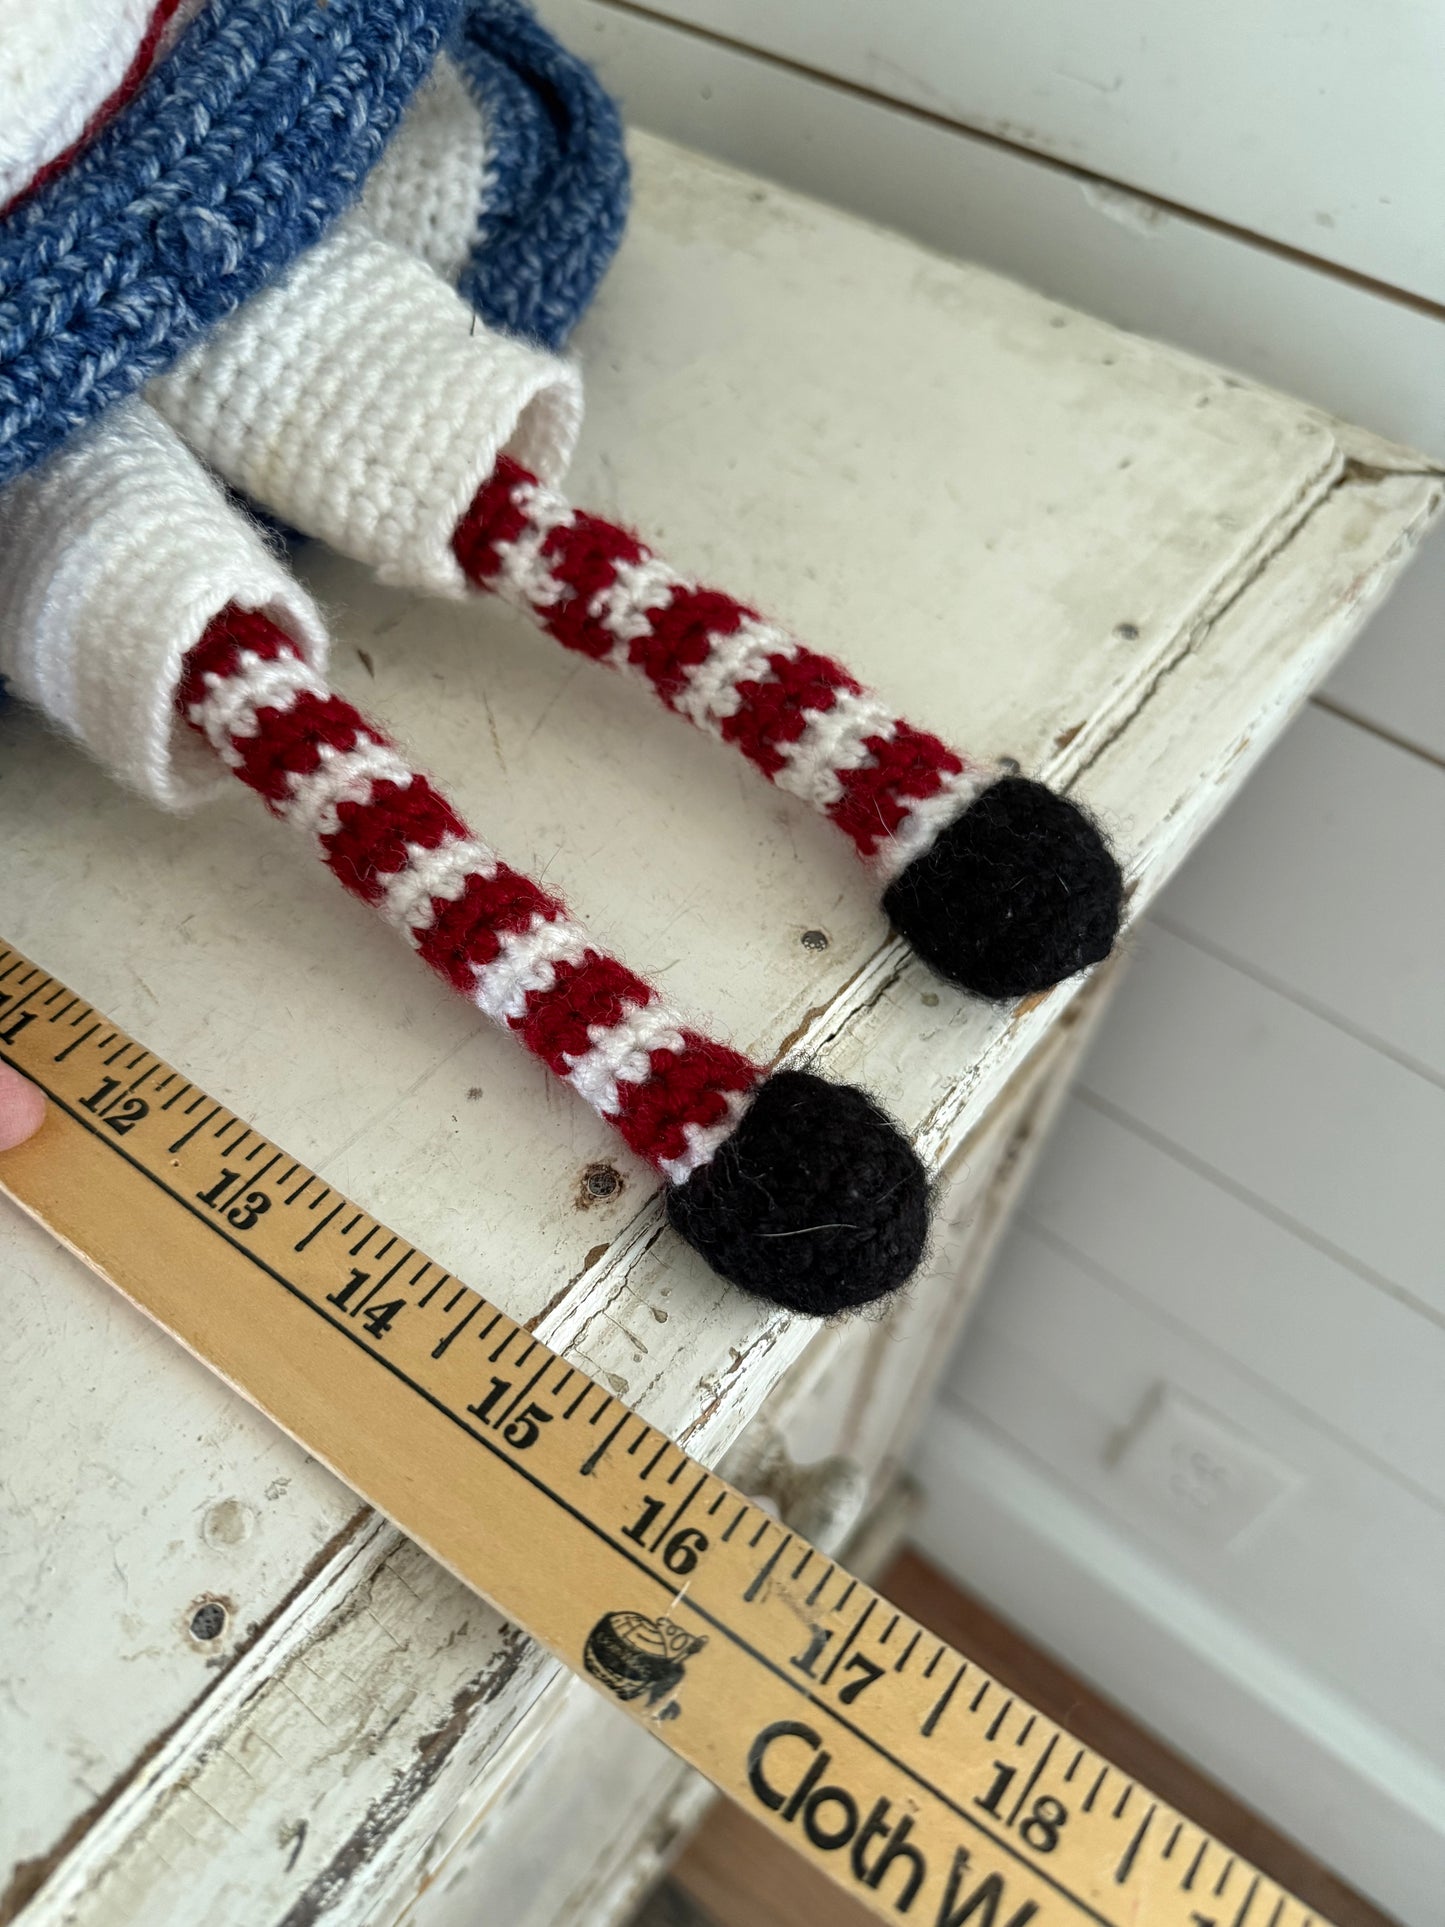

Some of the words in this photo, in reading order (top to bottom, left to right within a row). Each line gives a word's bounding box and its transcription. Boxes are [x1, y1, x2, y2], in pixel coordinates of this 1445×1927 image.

[0, 991, 38, 1045] 1
[79, 1076, 151, 1137] 12
[197, 1168, 273, 1231] 13
[326, 1267, 408, 1340] 14
[467, 1376, 555, 1450] 15
[621, 1495, 709, 1575] 16
[790, 1622, 886, 1704] 17
[973, 1760, 1069, 1853] 18
[747, 1720, 927, 1913] Cloth
